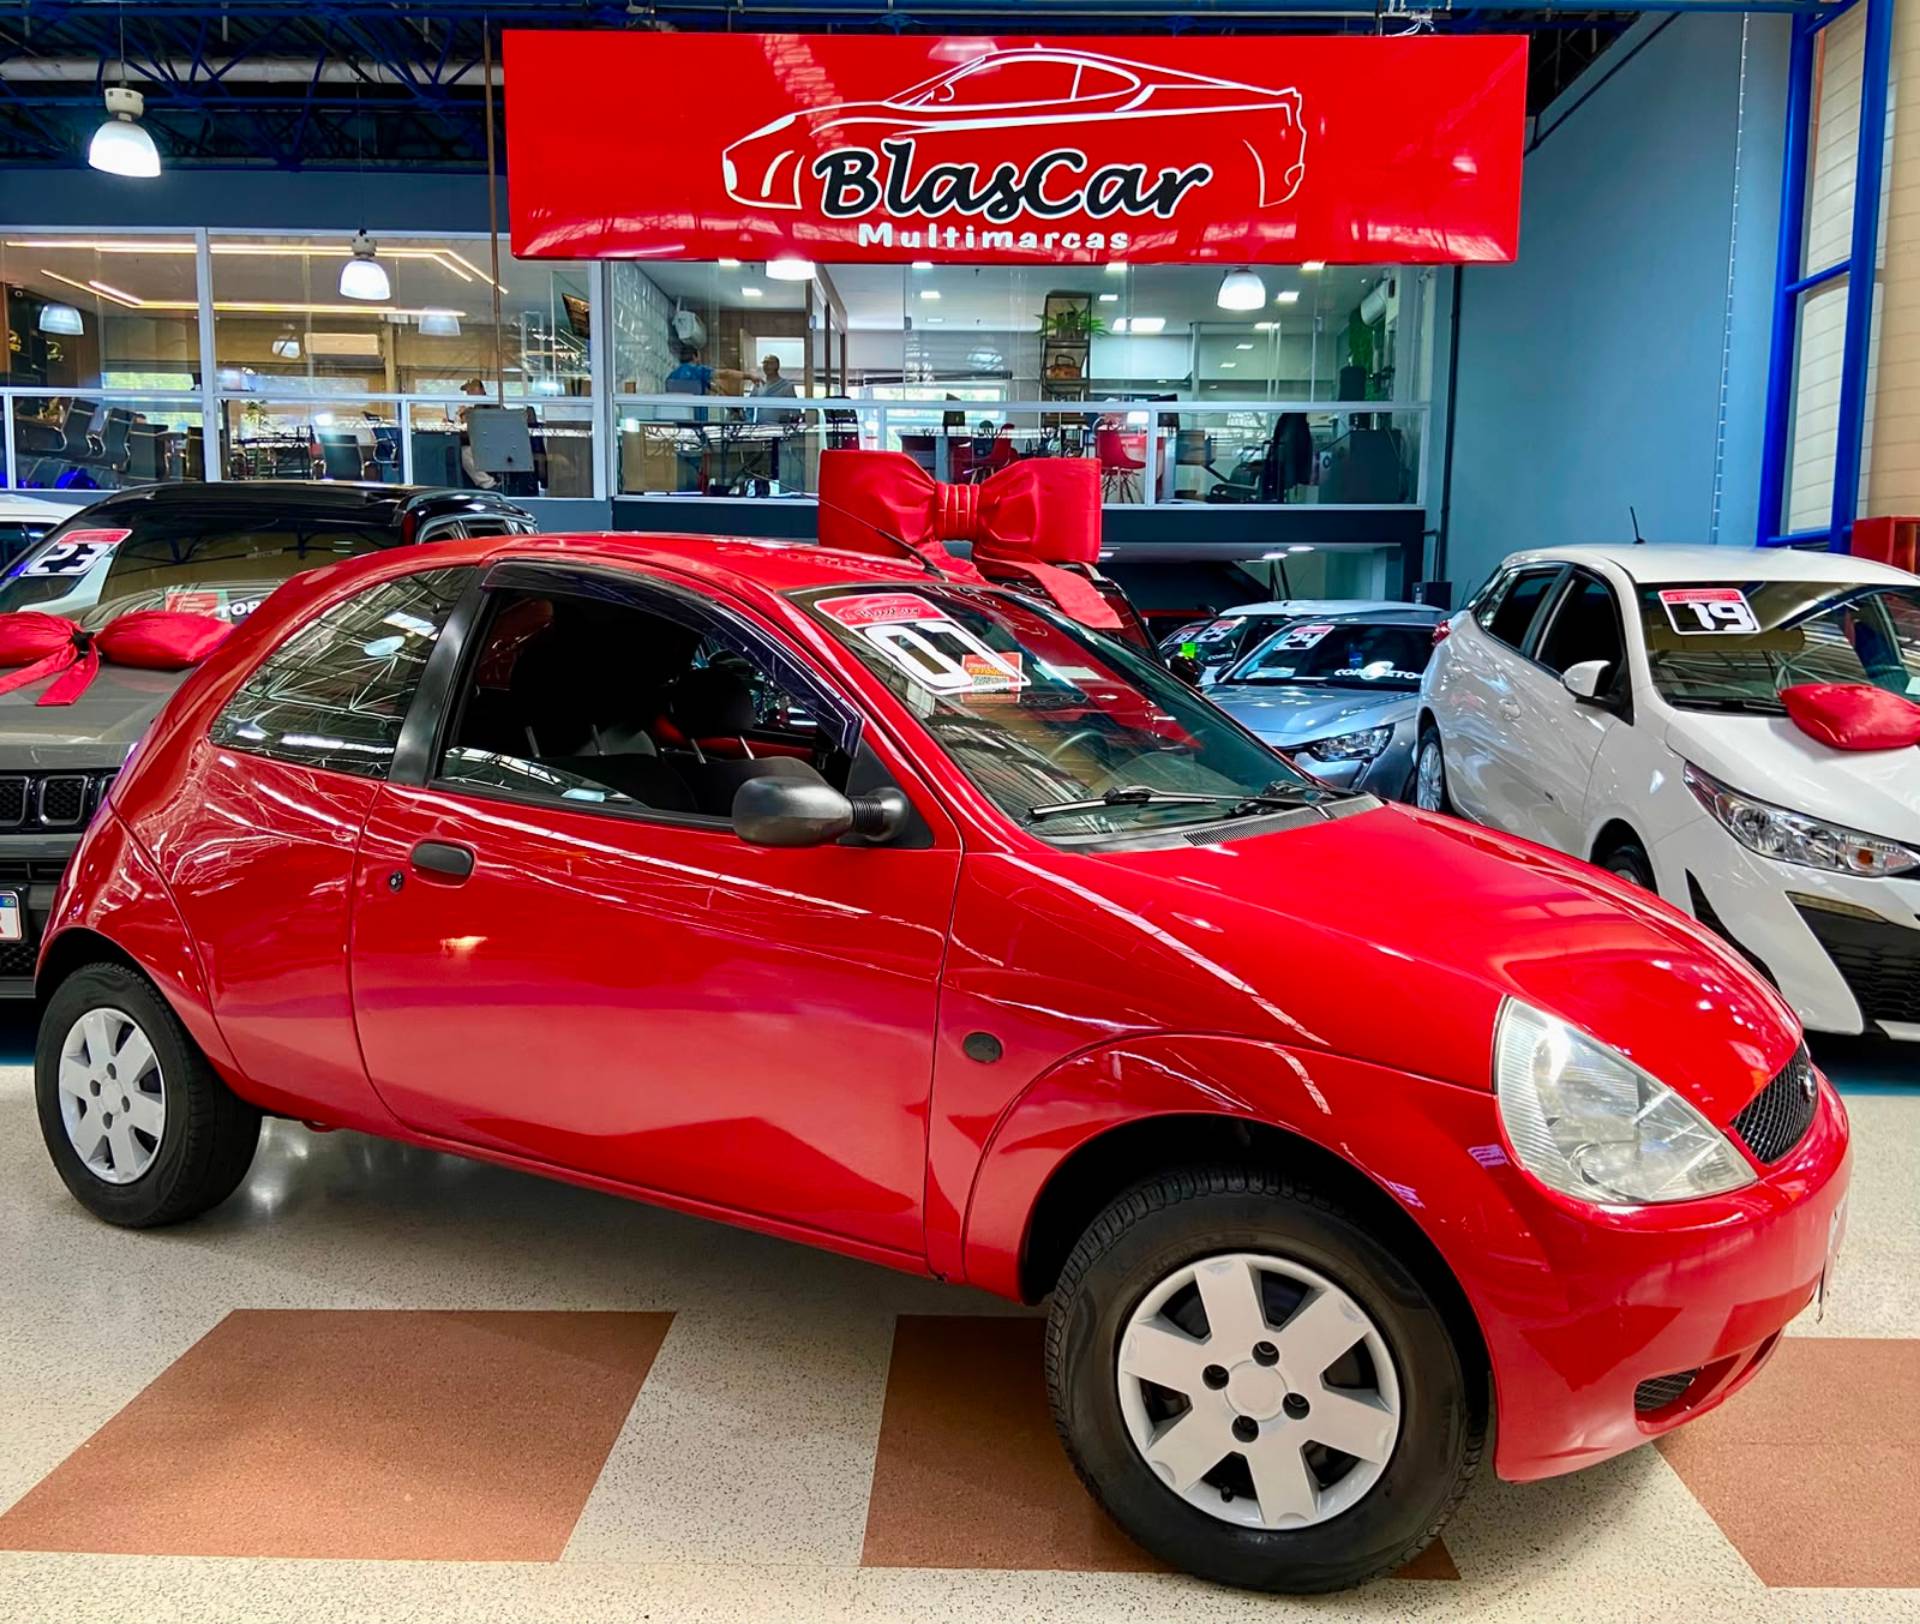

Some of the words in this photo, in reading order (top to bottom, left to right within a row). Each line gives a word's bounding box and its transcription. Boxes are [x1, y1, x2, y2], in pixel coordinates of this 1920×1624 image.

[812, 137, 1213, 224] BlasCar
[858, 222, 1129, 250] Multimarcas
[28, 543, 111, 574] 23
[1688, 602, 1753, 631] 19
